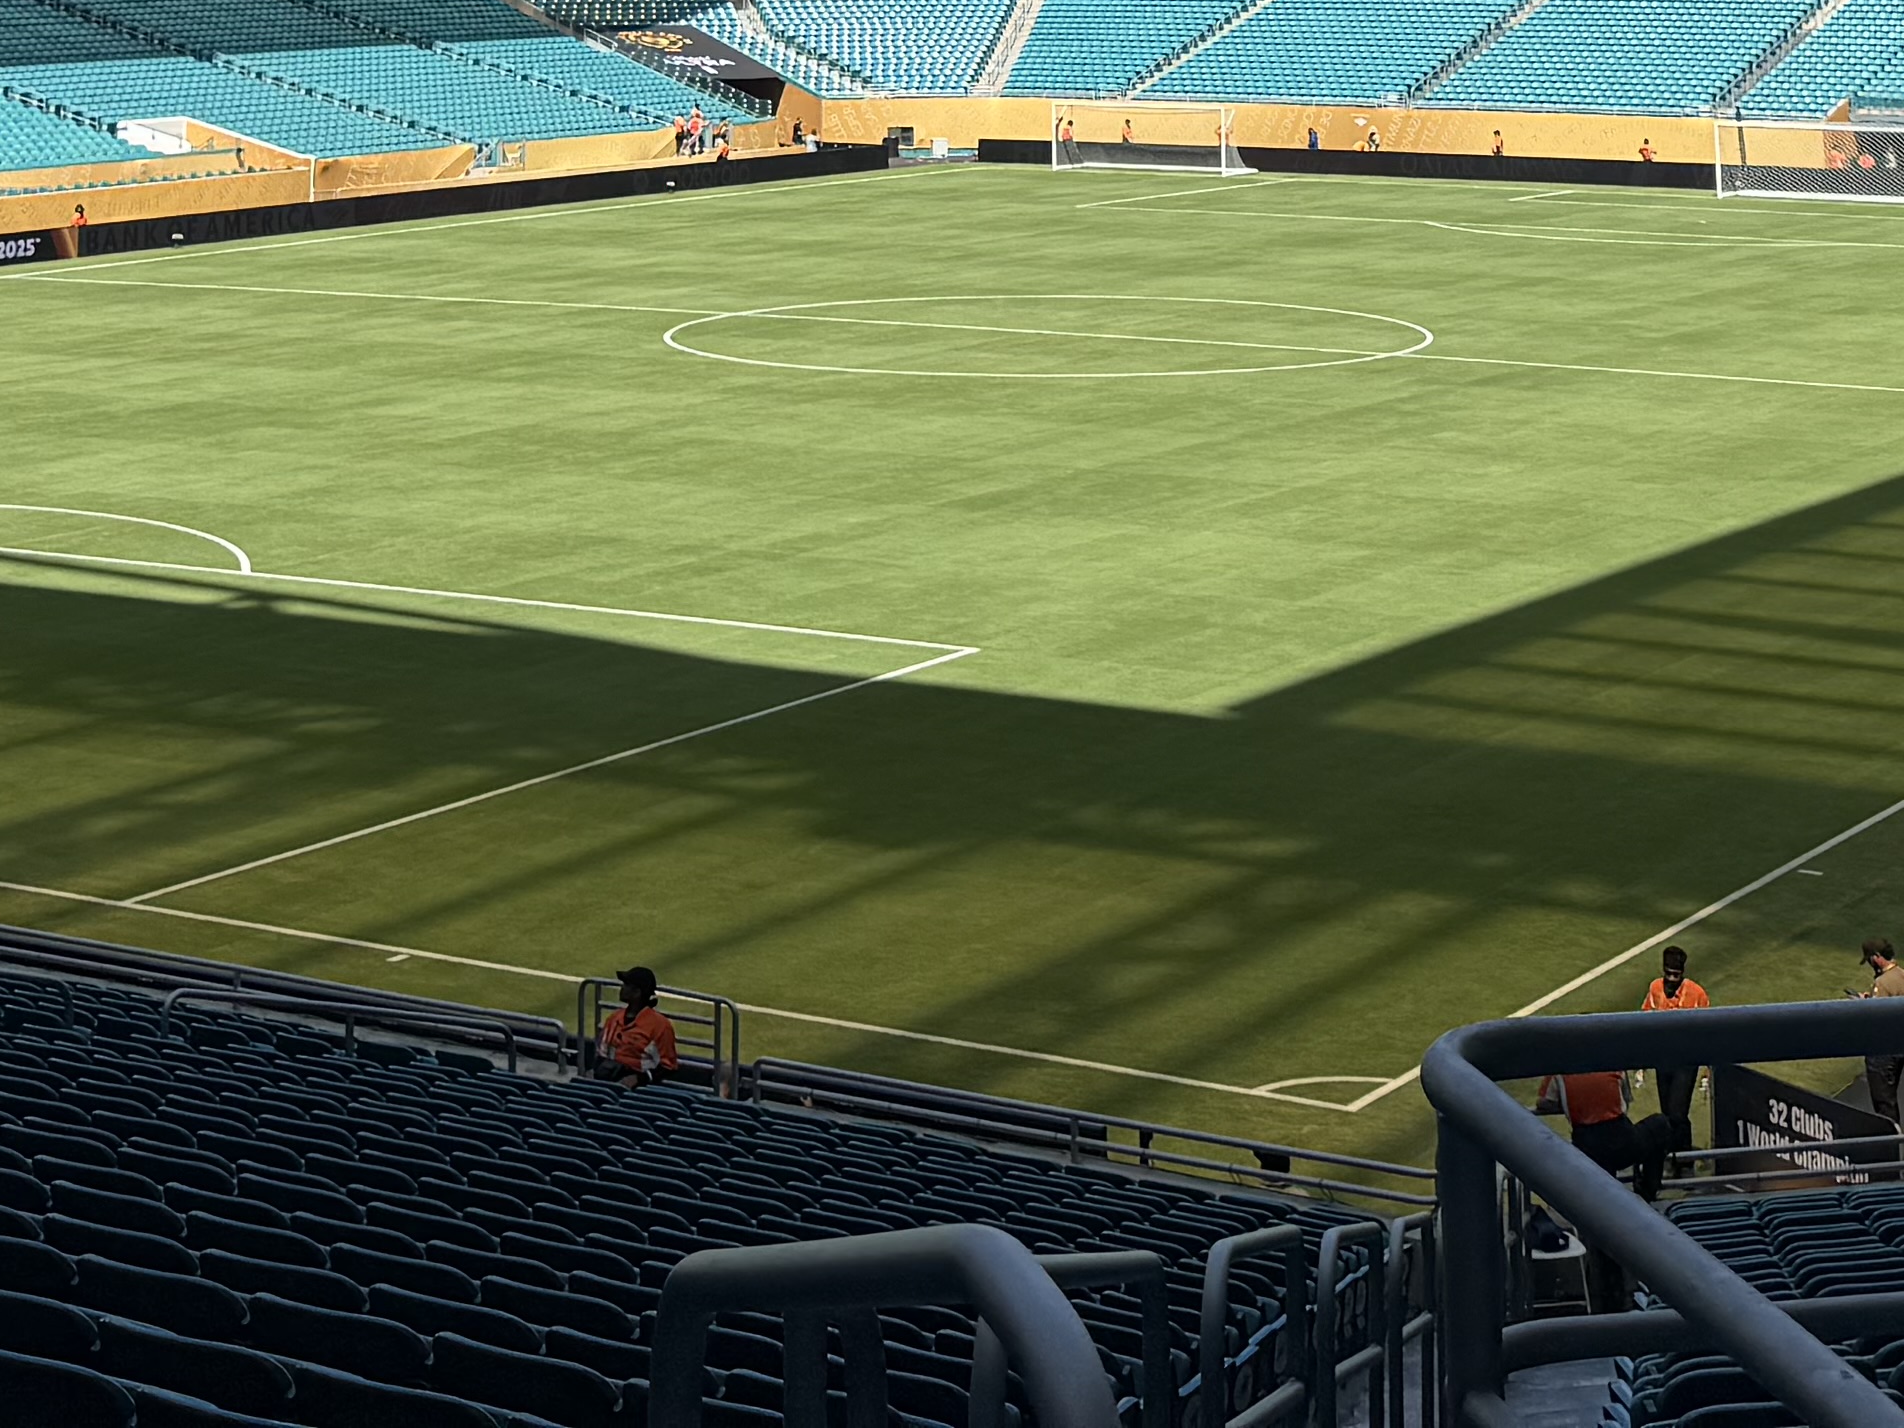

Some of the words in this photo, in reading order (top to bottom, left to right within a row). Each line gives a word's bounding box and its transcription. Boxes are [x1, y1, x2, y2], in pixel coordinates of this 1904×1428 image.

[86, 221, 159, 253] BANK
[206, 204, 316, 239] AMERICA
[1737, 1120, 1744, 1145] 1
[1768, 1099, 1787, 1128] 32
[1791, 1105, 1834, 1141] Clubs
